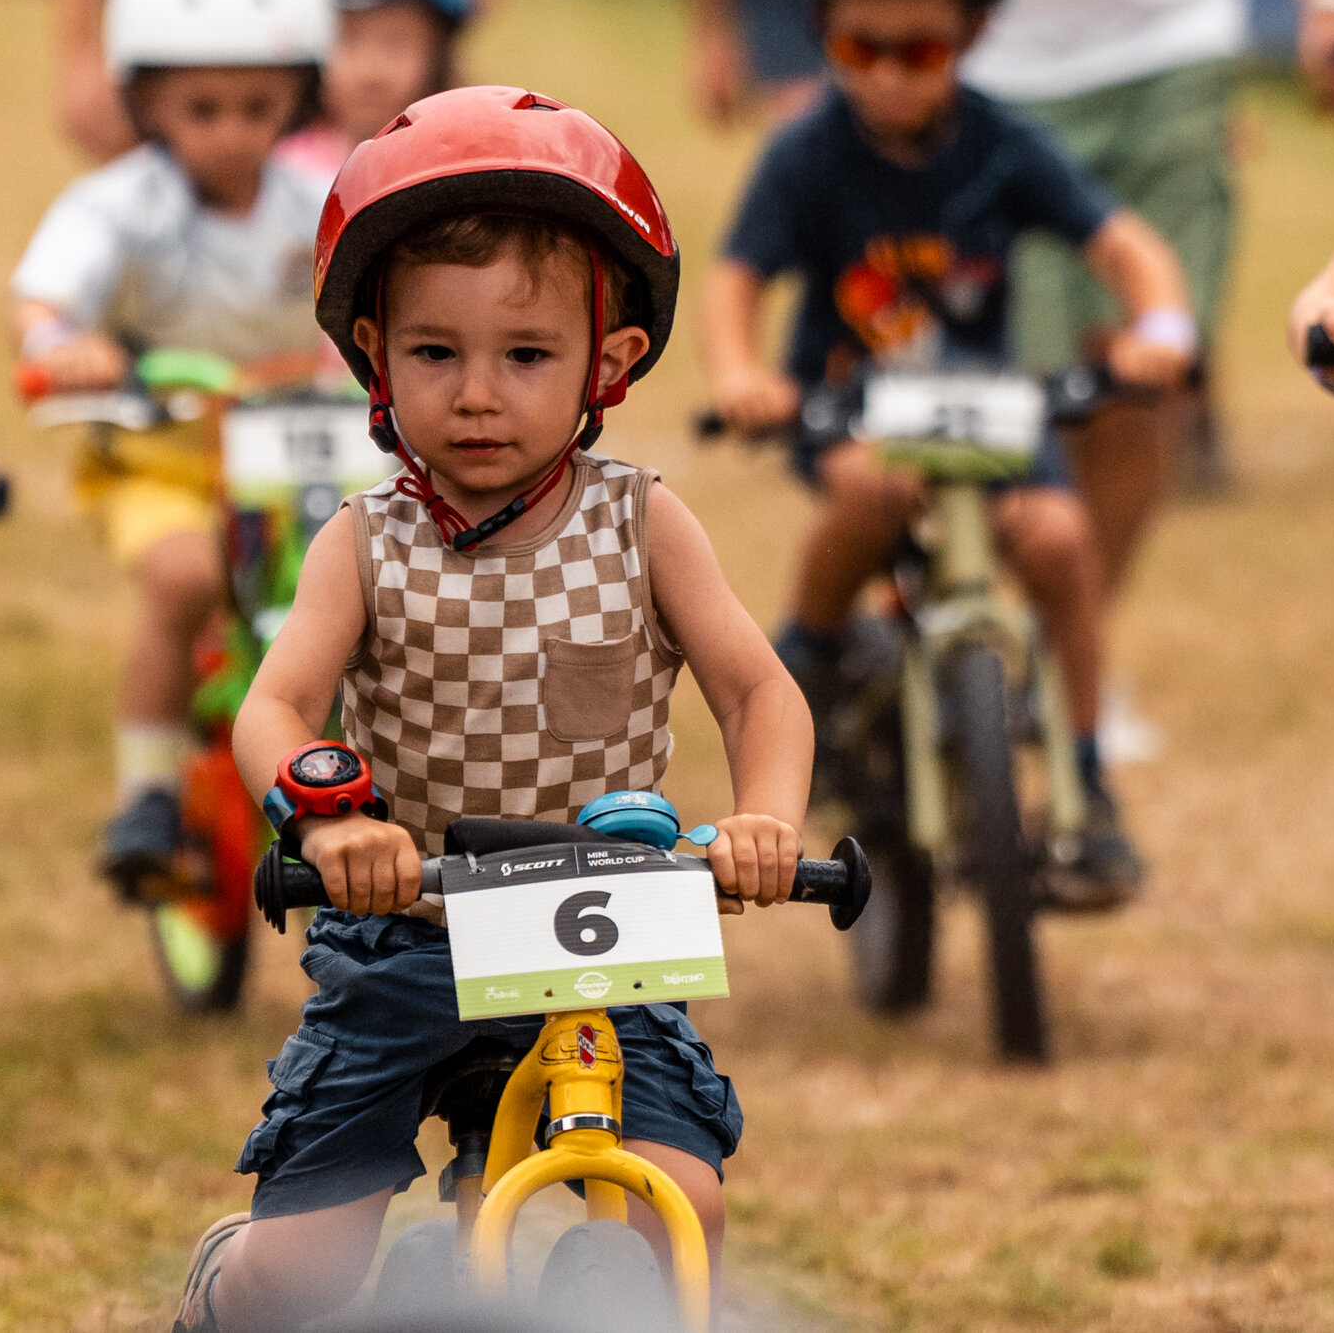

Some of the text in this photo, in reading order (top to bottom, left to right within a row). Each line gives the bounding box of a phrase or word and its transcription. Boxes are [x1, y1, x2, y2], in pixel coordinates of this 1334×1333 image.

[587, 851, 608, 860] MINI
[588, 856, 645, 867] WORLD CUP
[512, 858, 565, 872] SCOTT
[554, 890, 619, 957] 6
